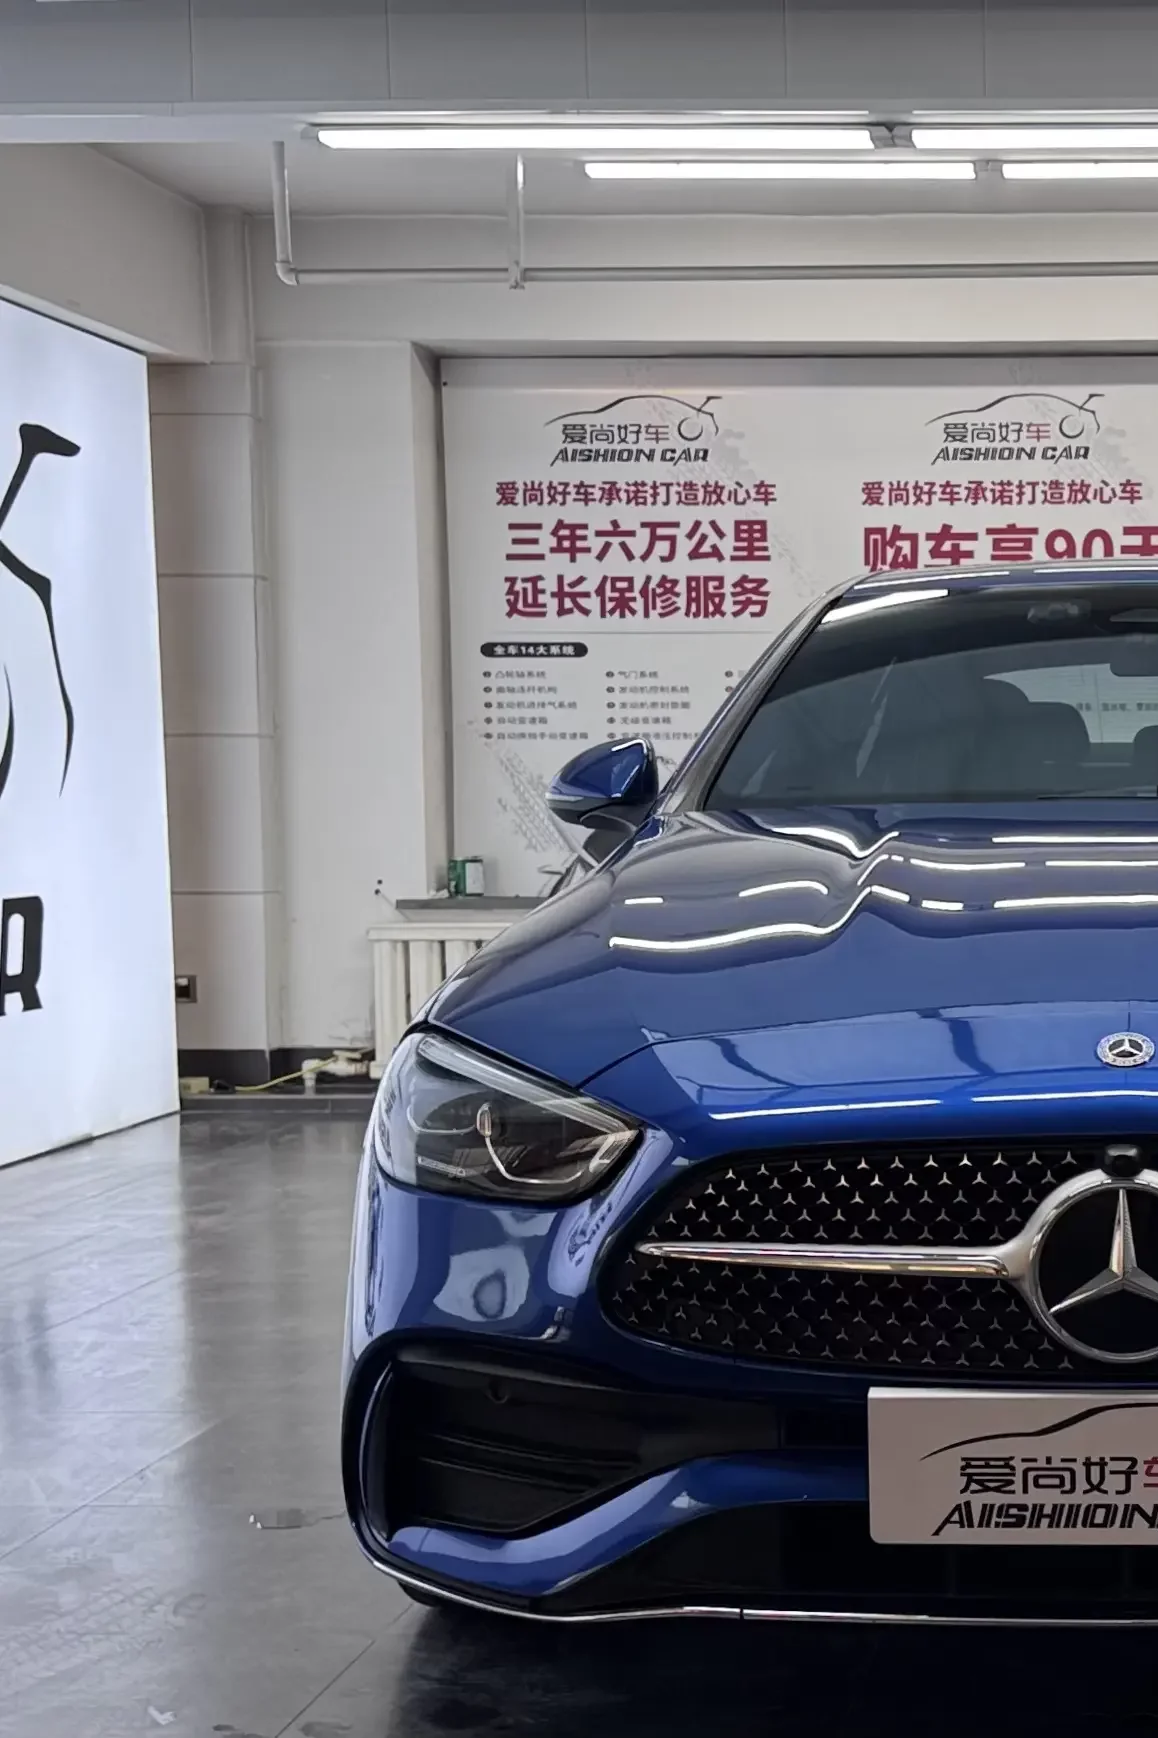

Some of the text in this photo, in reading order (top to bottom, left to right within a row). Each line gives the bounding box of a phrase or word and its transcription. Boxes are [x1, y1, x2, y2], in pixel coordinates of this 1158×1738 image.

[562, 424, 670, 444] 爱尚好车
[943, 422, 1051, 443] 爱尚好车
[551, 447, 709, 466] AISHION CAR
[931, 445, 1090, 465] AISHION CAR
[495, 481, 777, 506] 爱尚好车承诺打造放心车
[861, 479, 1143, 506] 爱尚好车承诺打造放心车
[505, 519, 771, 563] 三年六万公里
[504, 574, 771, 619] 延长保修服务
